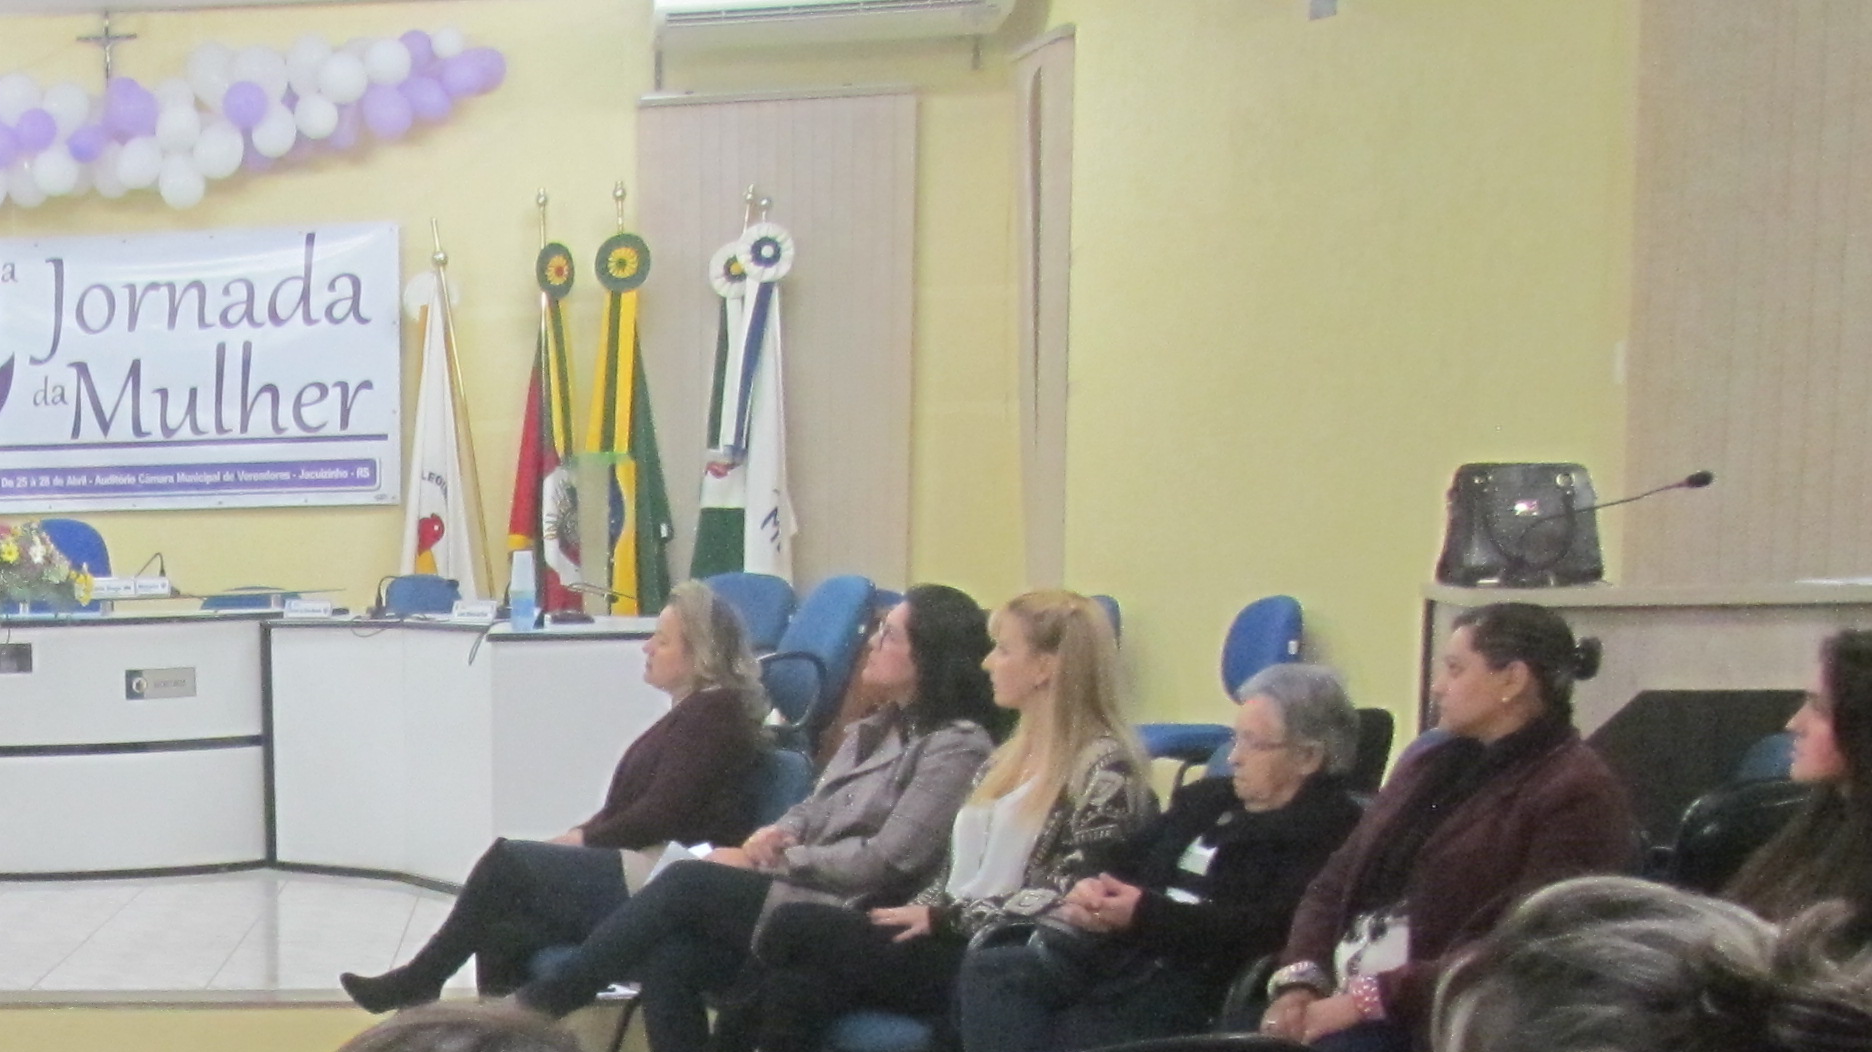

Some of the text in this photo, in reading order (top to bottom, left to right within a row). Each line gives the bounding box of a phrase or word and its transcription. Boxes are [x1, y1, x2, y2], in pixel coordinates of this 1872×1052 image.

[29, 231, 373, 366] Jornada
[32, 340, 374, 440] da Mulher
[1, 477, 14, 489] De
[16, 476, 28, 488] 25
[39, 475, 50, 488] 28
[53, 475, 64, 487] de
[66, 475, 87, 487] Abril
[138, 472, 175, 485] Câmara
[176, 471, 221, 485] Municipal
[223, 470, 234, 482] de
[236, 469, 291, 482] Vereadores
[298, 467, 349, 480] Jacuizinho
[356, 467, 370, 479] RS
